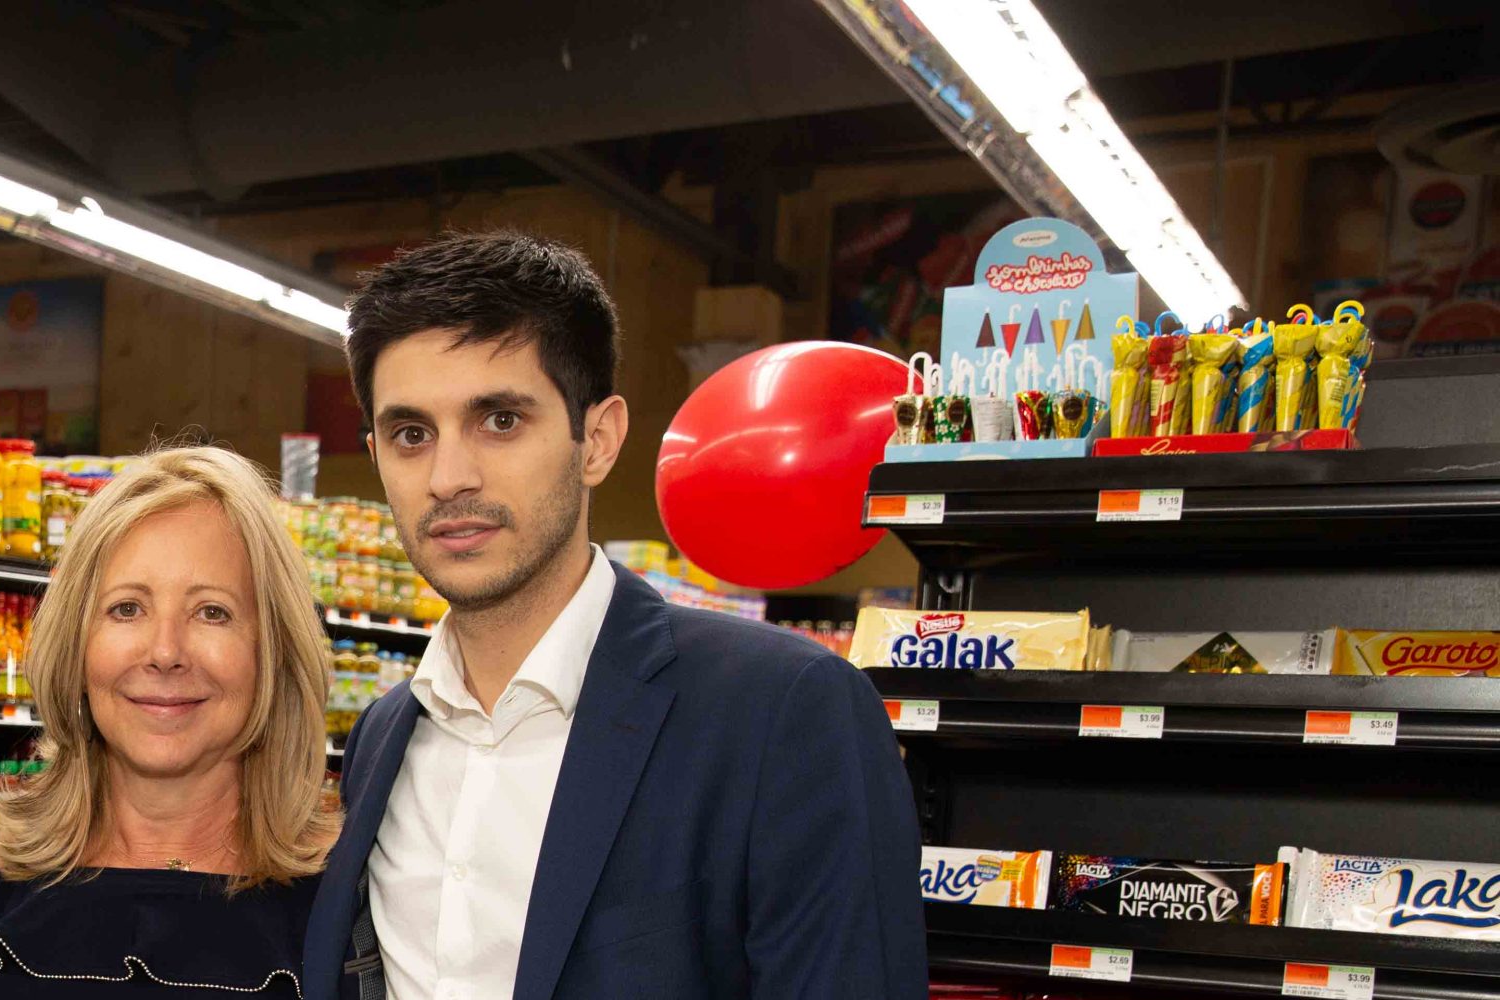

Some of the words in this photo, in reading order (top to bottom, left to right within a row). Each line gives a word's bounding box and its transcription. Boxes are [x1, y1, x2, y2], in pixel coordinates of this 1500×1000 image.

[922, 502, 941, 510] $2.39
[1158, 497, 1179, 505] $1.19
[892, 633, 1015, 670] Galak
[1382, 636, 1499, 669] Garoto
[916, 707, 936, 716] $3.29
[1139, 714, 1160, 722] $3.99
[1370, 720, 1393, 729] $3.49
[1076, 863, 1111, 878] LACTA
[1335, 859, 1383, 874] LACTA
[919, 860, 978, 895] aka
[1120, 880, 1206, 904] DIAMANTE
[1118, 900, 1207, 921] NEGRO
[1348, 973, 1371, 983] $3.99
